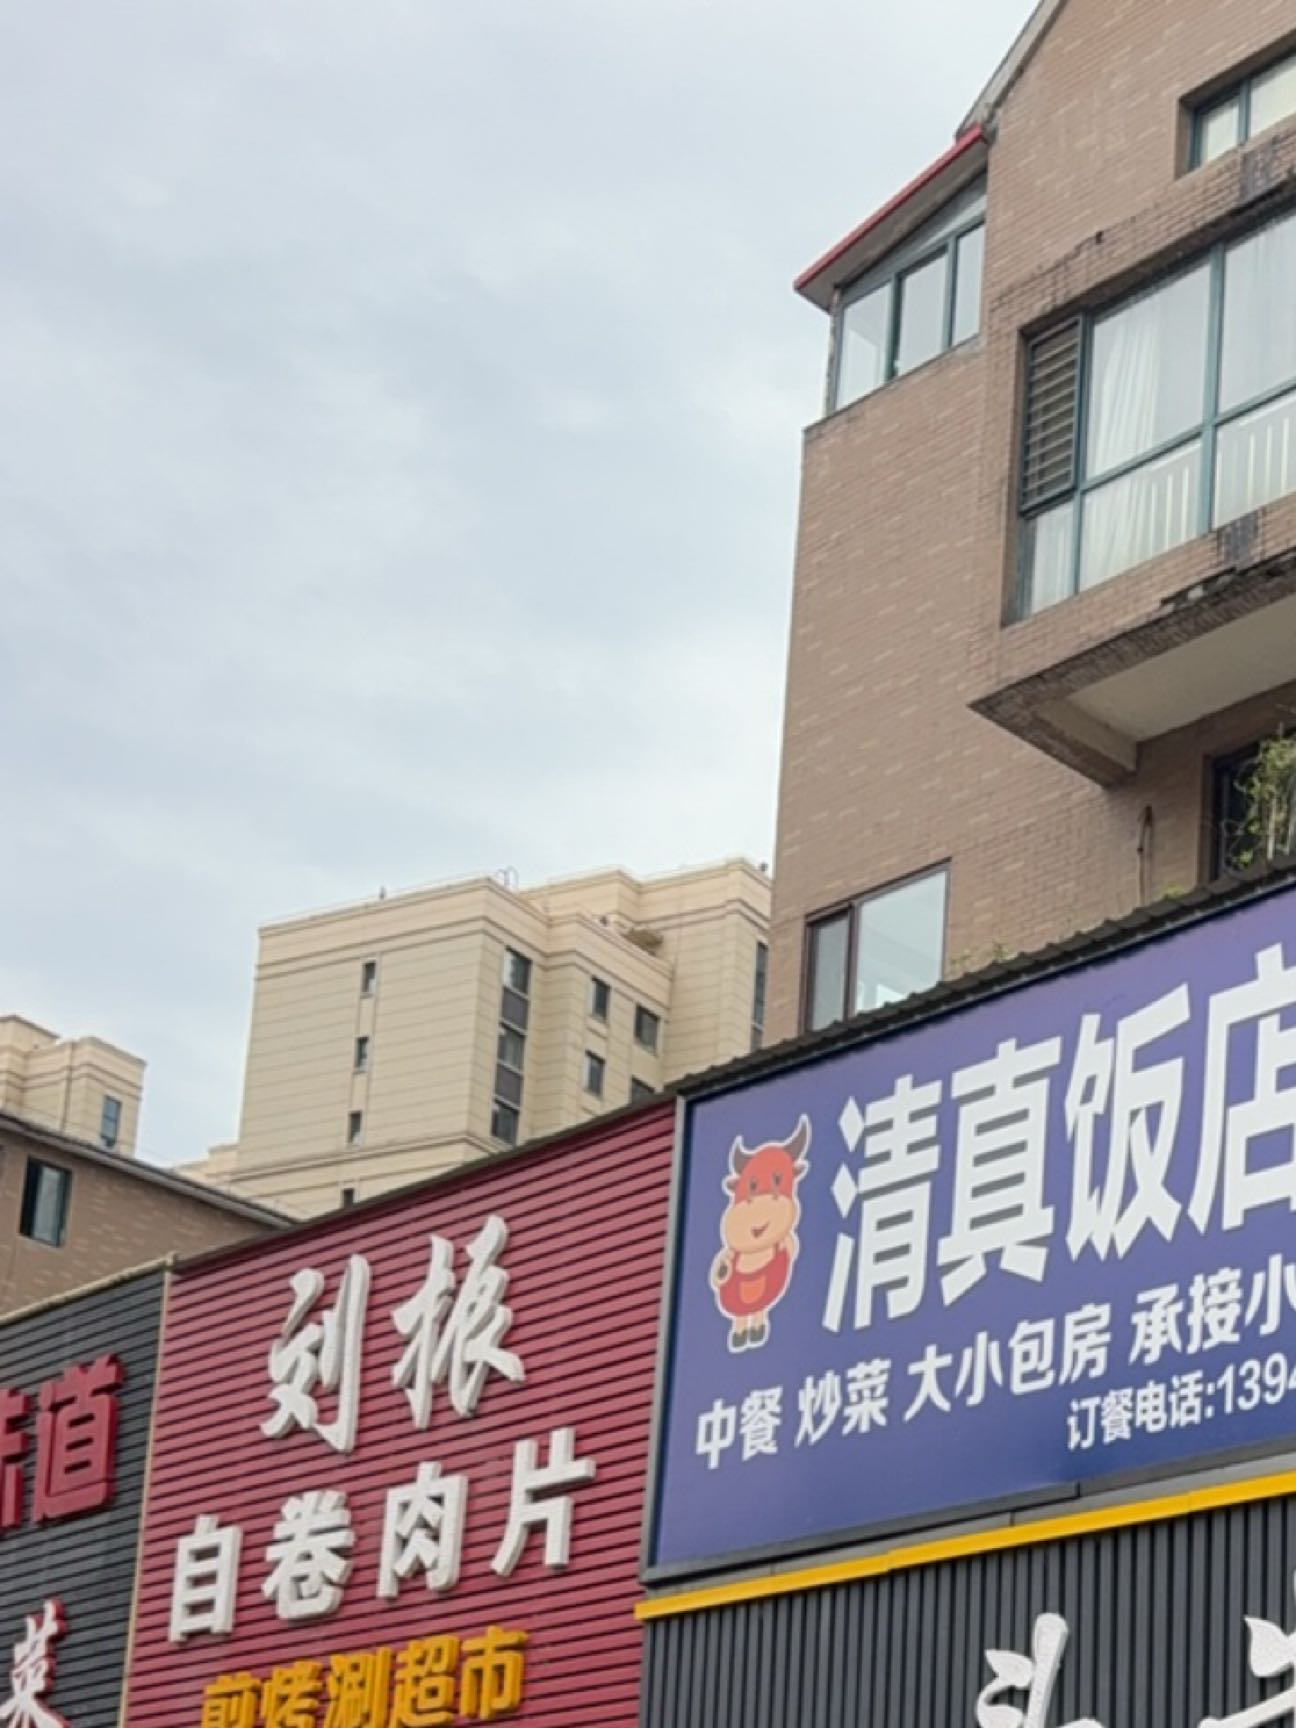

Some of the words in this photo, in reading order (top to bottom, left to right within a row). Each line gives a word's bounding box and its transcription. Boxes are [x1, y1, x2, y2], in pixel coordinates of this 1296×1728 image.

[0, 1351, 124, 1530] 道
[695, 1384, 784, 1470] 中餐
[794, 1356, 890, 1448] 炒菜
[904, 1302, 1111, 1423] 大小包房
[168, 1426, 597, 1644] 自卷肉片
